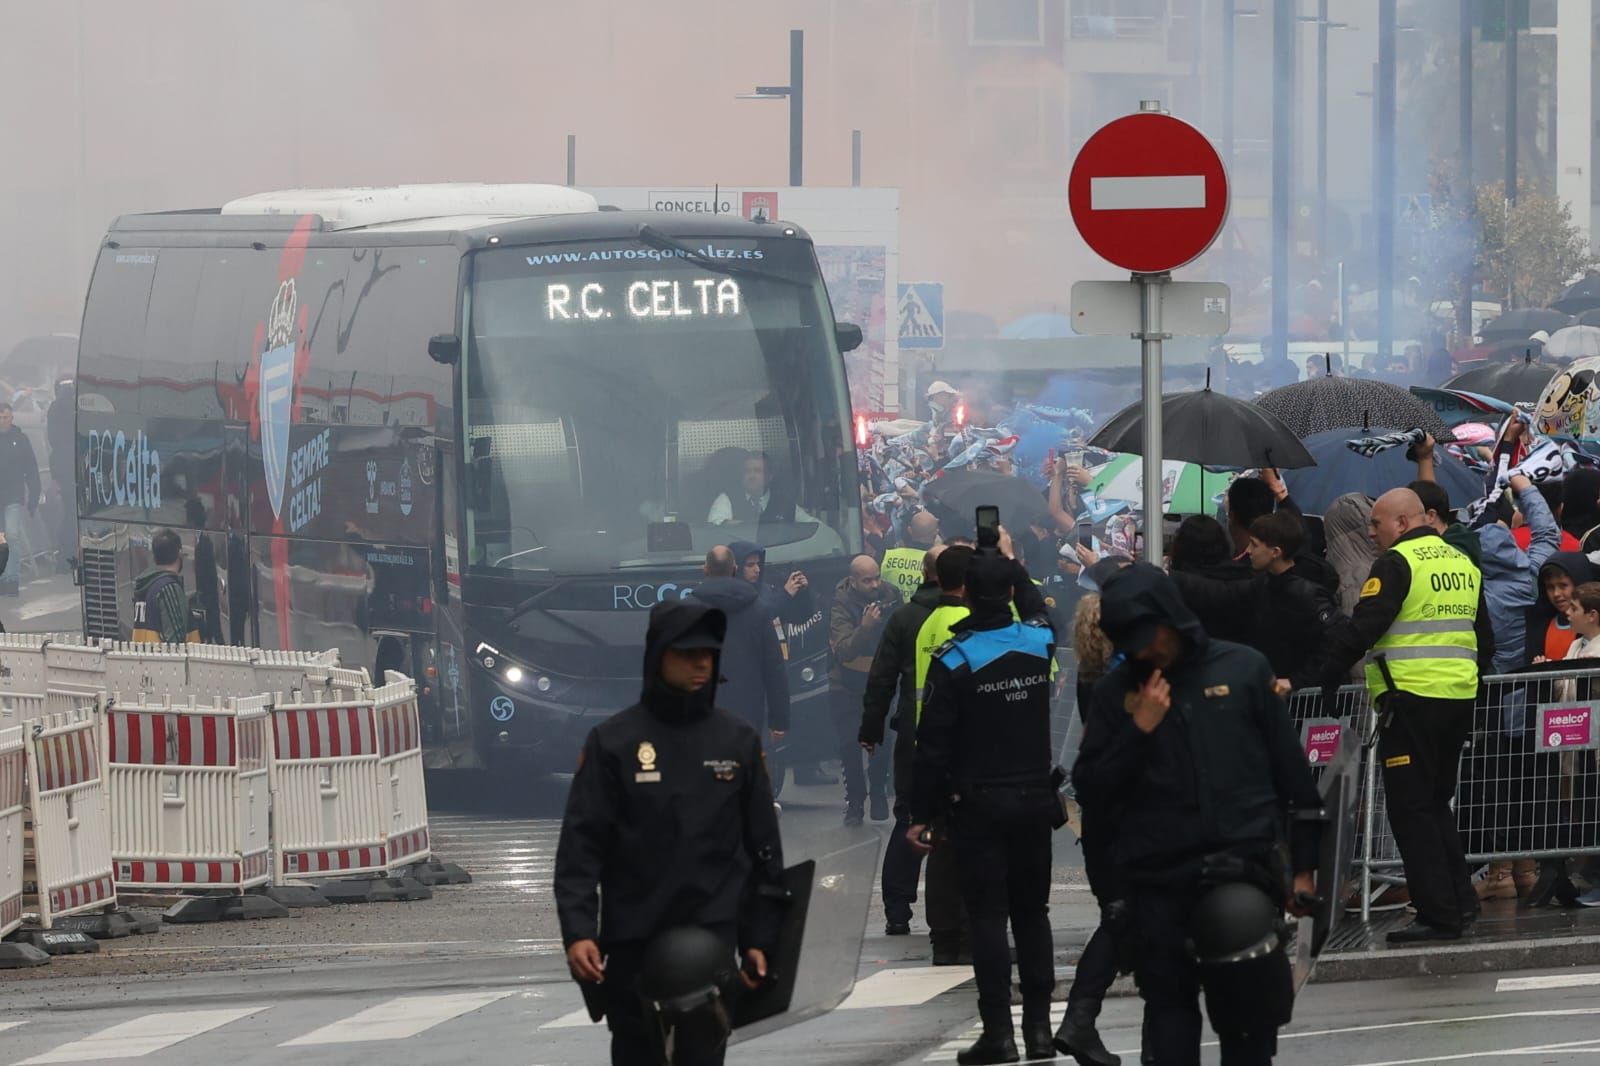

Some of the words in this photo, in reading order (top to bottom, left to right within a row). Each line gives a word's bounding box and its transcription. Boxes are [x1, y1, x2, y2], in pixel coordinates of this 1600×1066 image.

[654, 200, 731, 214] CONCELLO
[546, 282, 612, 320] R.C.
[627, 278, 741, 318] CELTA
[291, 427, 331, 489] SEMPRE
[289, 476, 322, 533] CELTA!
[1430, 572, 1475, 593] 00074
[1005, 690, 1028, 702] VIGO
